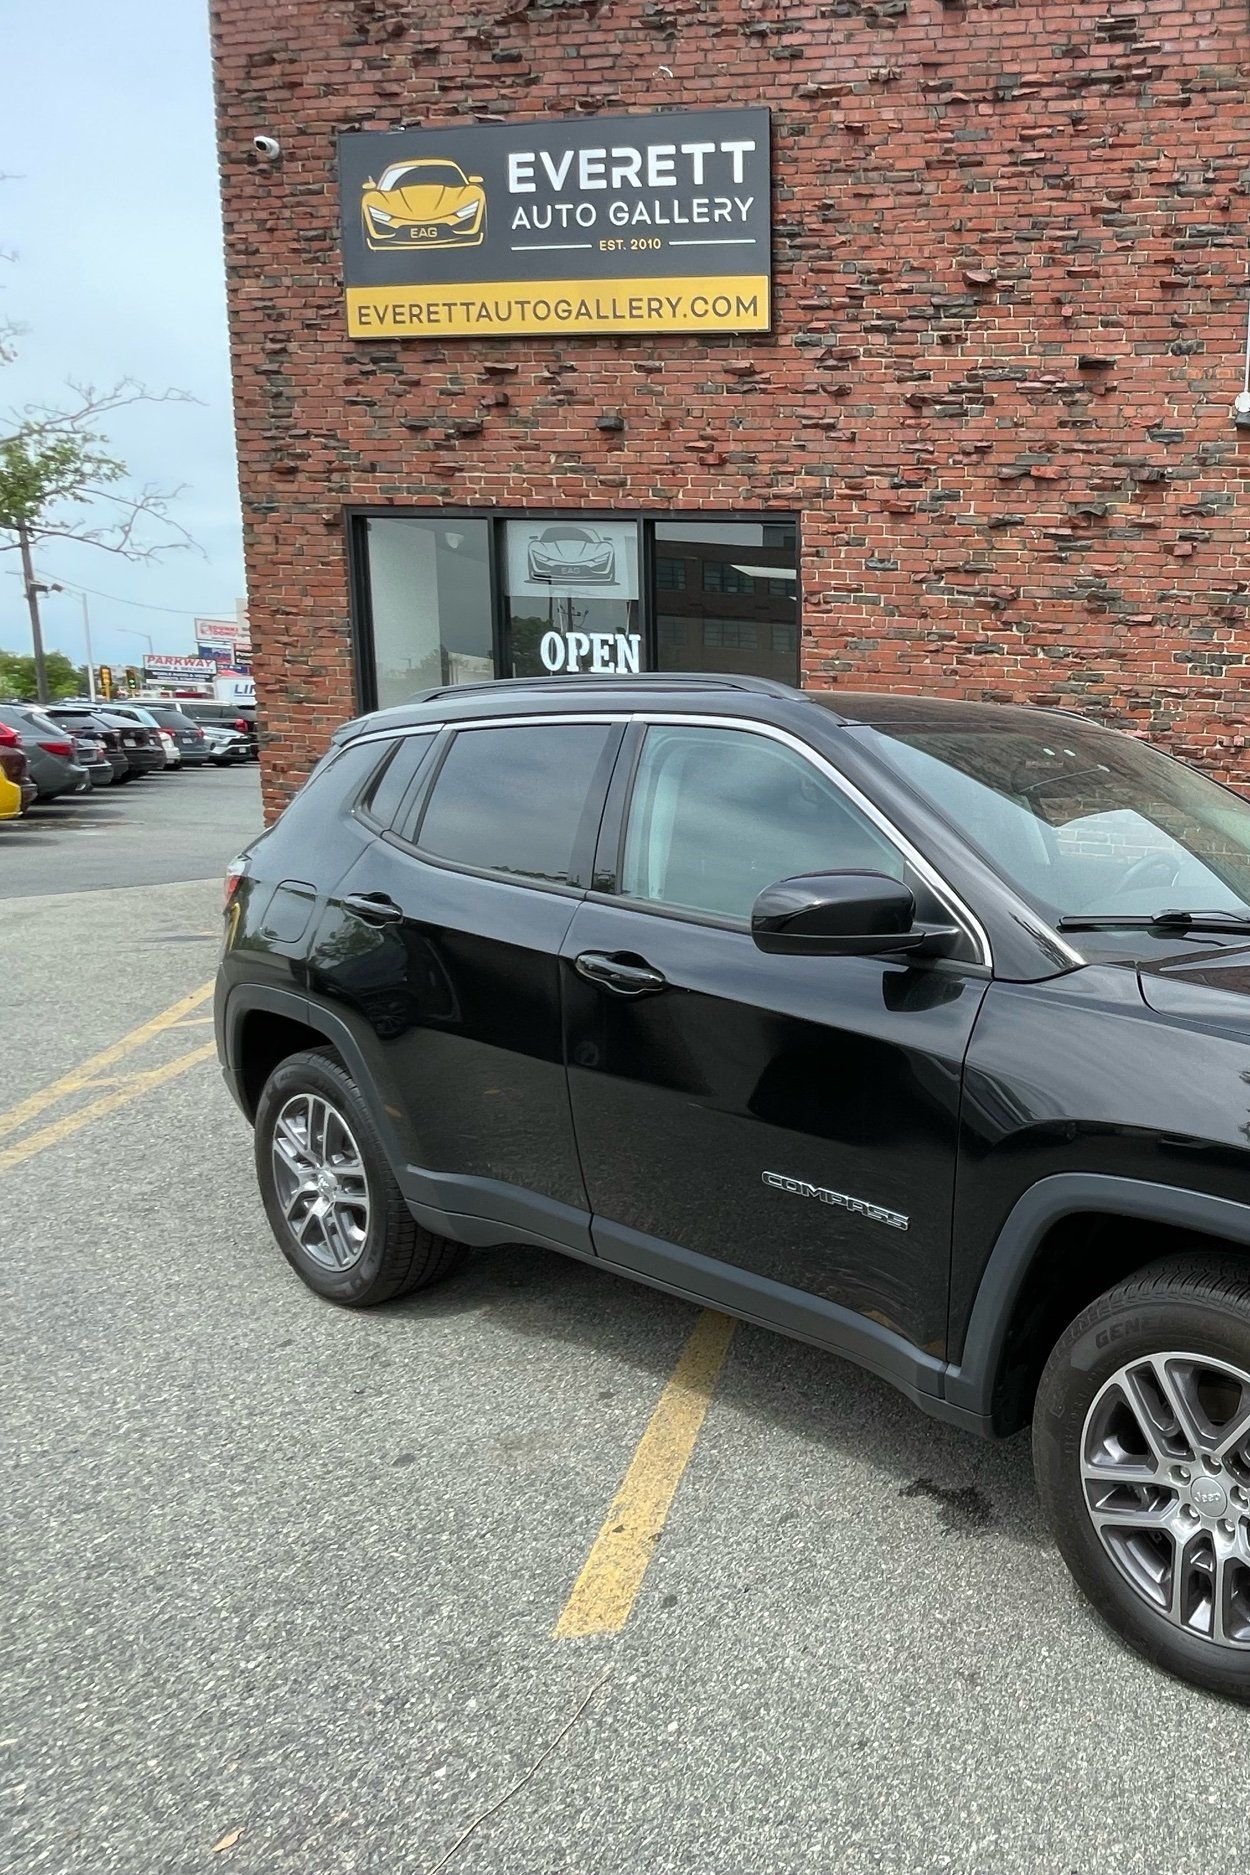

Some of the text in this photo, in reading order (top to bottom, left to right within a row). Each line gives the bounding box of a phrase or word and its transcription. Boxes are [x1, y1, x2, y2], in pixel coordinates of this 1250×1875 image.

[508, 141, 757, 193] EVERETT
[511, 197, 755, 230] AUTO GALLERY
[410, 227, 438, 239] EAG
[599, 238, 661, 251] EST. 2010
[358, 295, 758, 326] EVERETTAUTOGALLERY.COM
[147, 655, 213, 667] PARKWAY
[540, 631, 641, 673] OPEN
[762, 1171, 910, 1231] COMPASS
